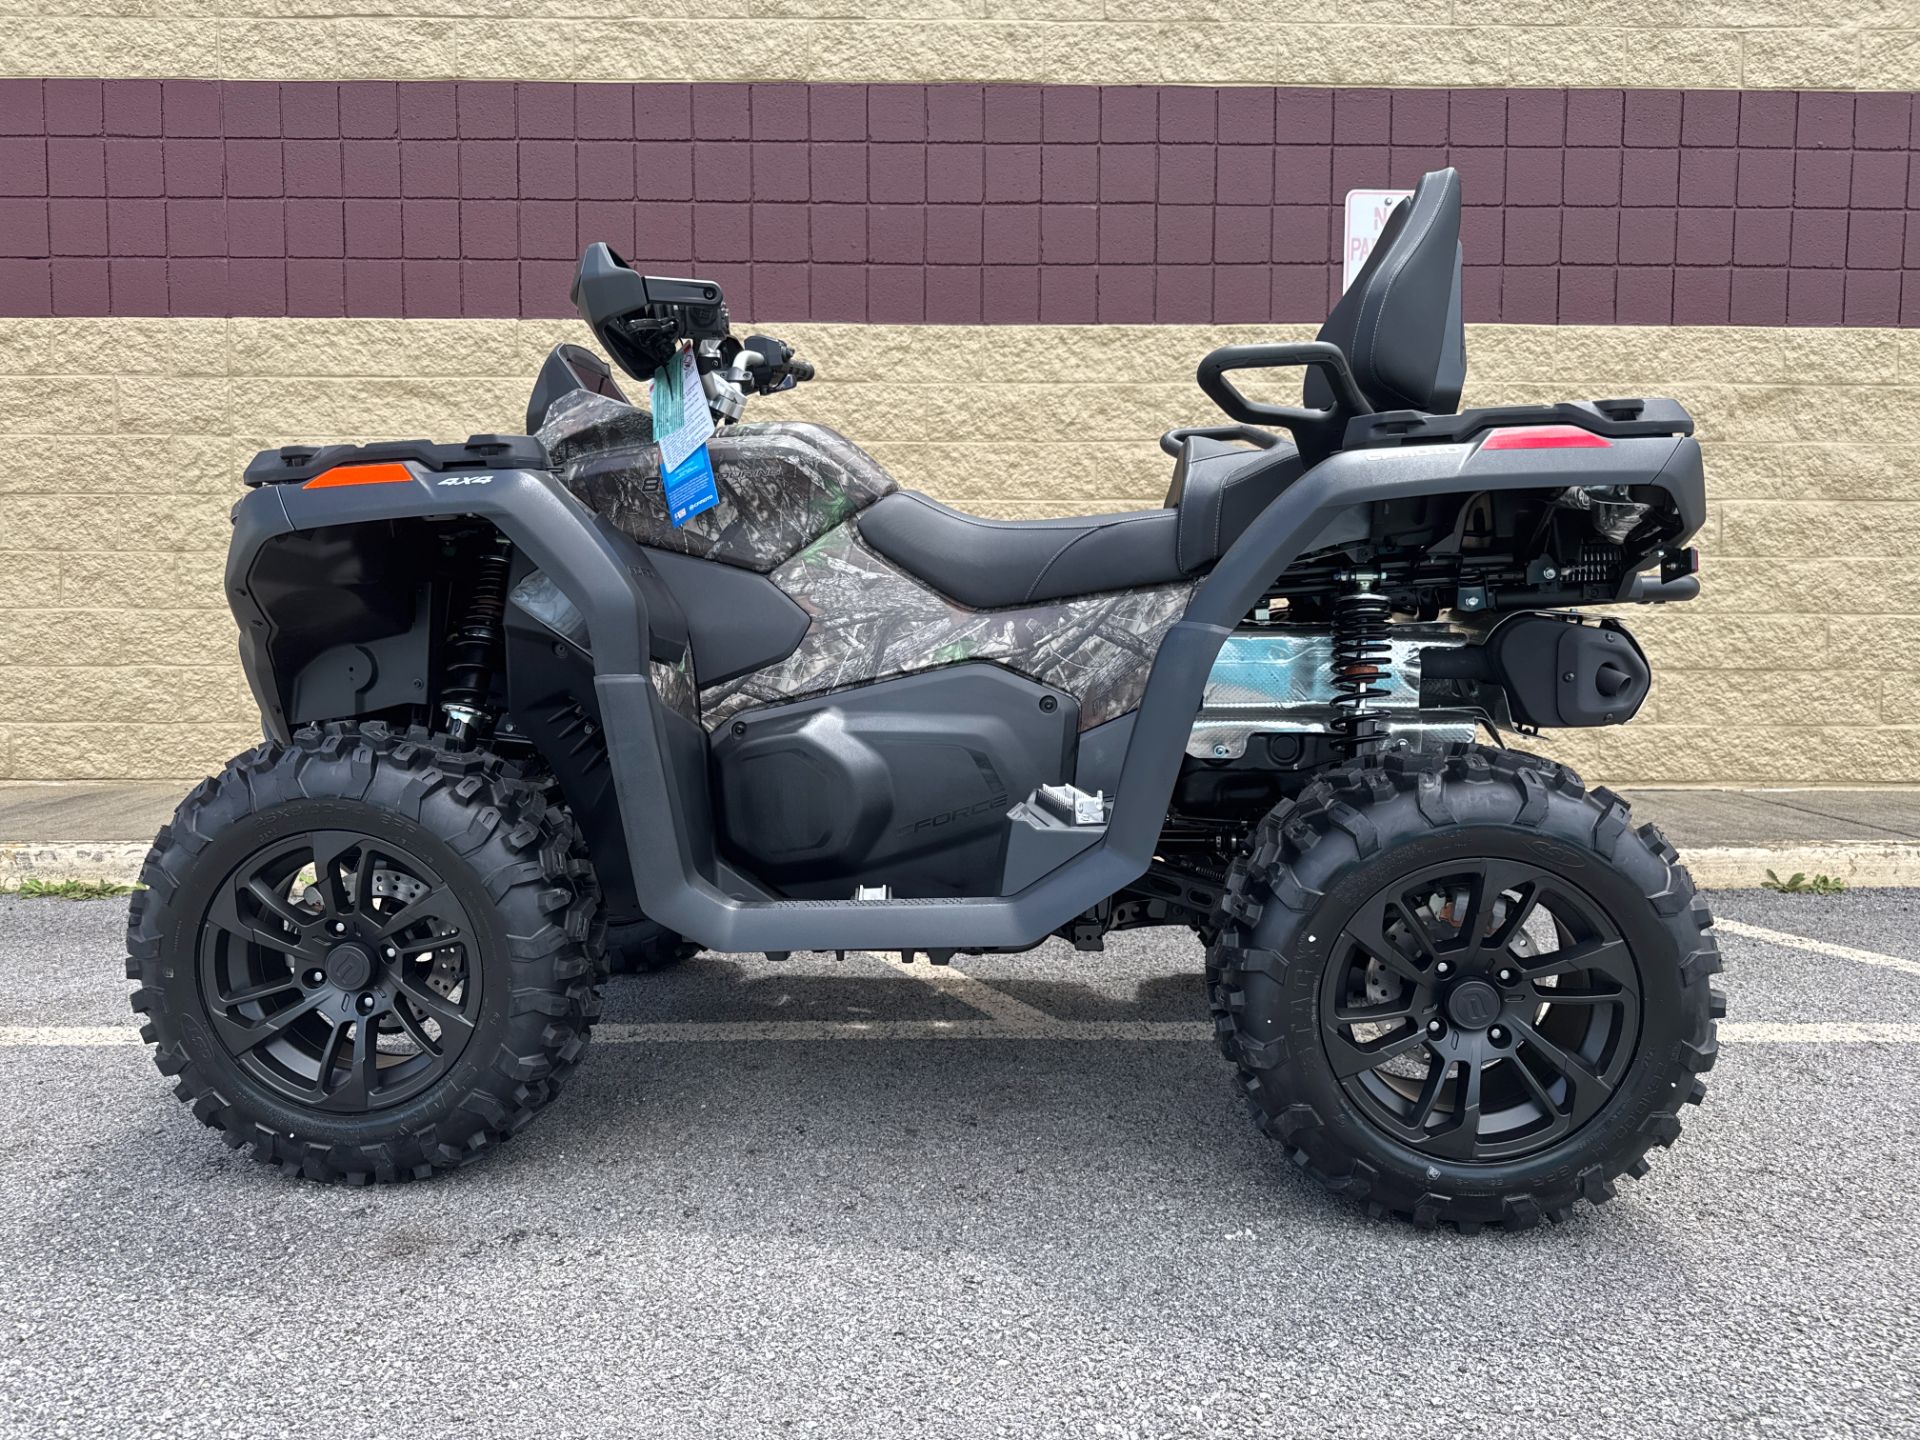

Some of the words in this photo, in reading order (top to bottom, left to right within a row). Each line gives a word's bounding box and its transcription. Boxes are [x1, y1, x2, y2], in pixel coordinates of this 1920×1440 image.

[1374, 207, 1388, 231] N
[1351, 238, 1376, 262] PA
[717, 468, 782, 480] OURING
